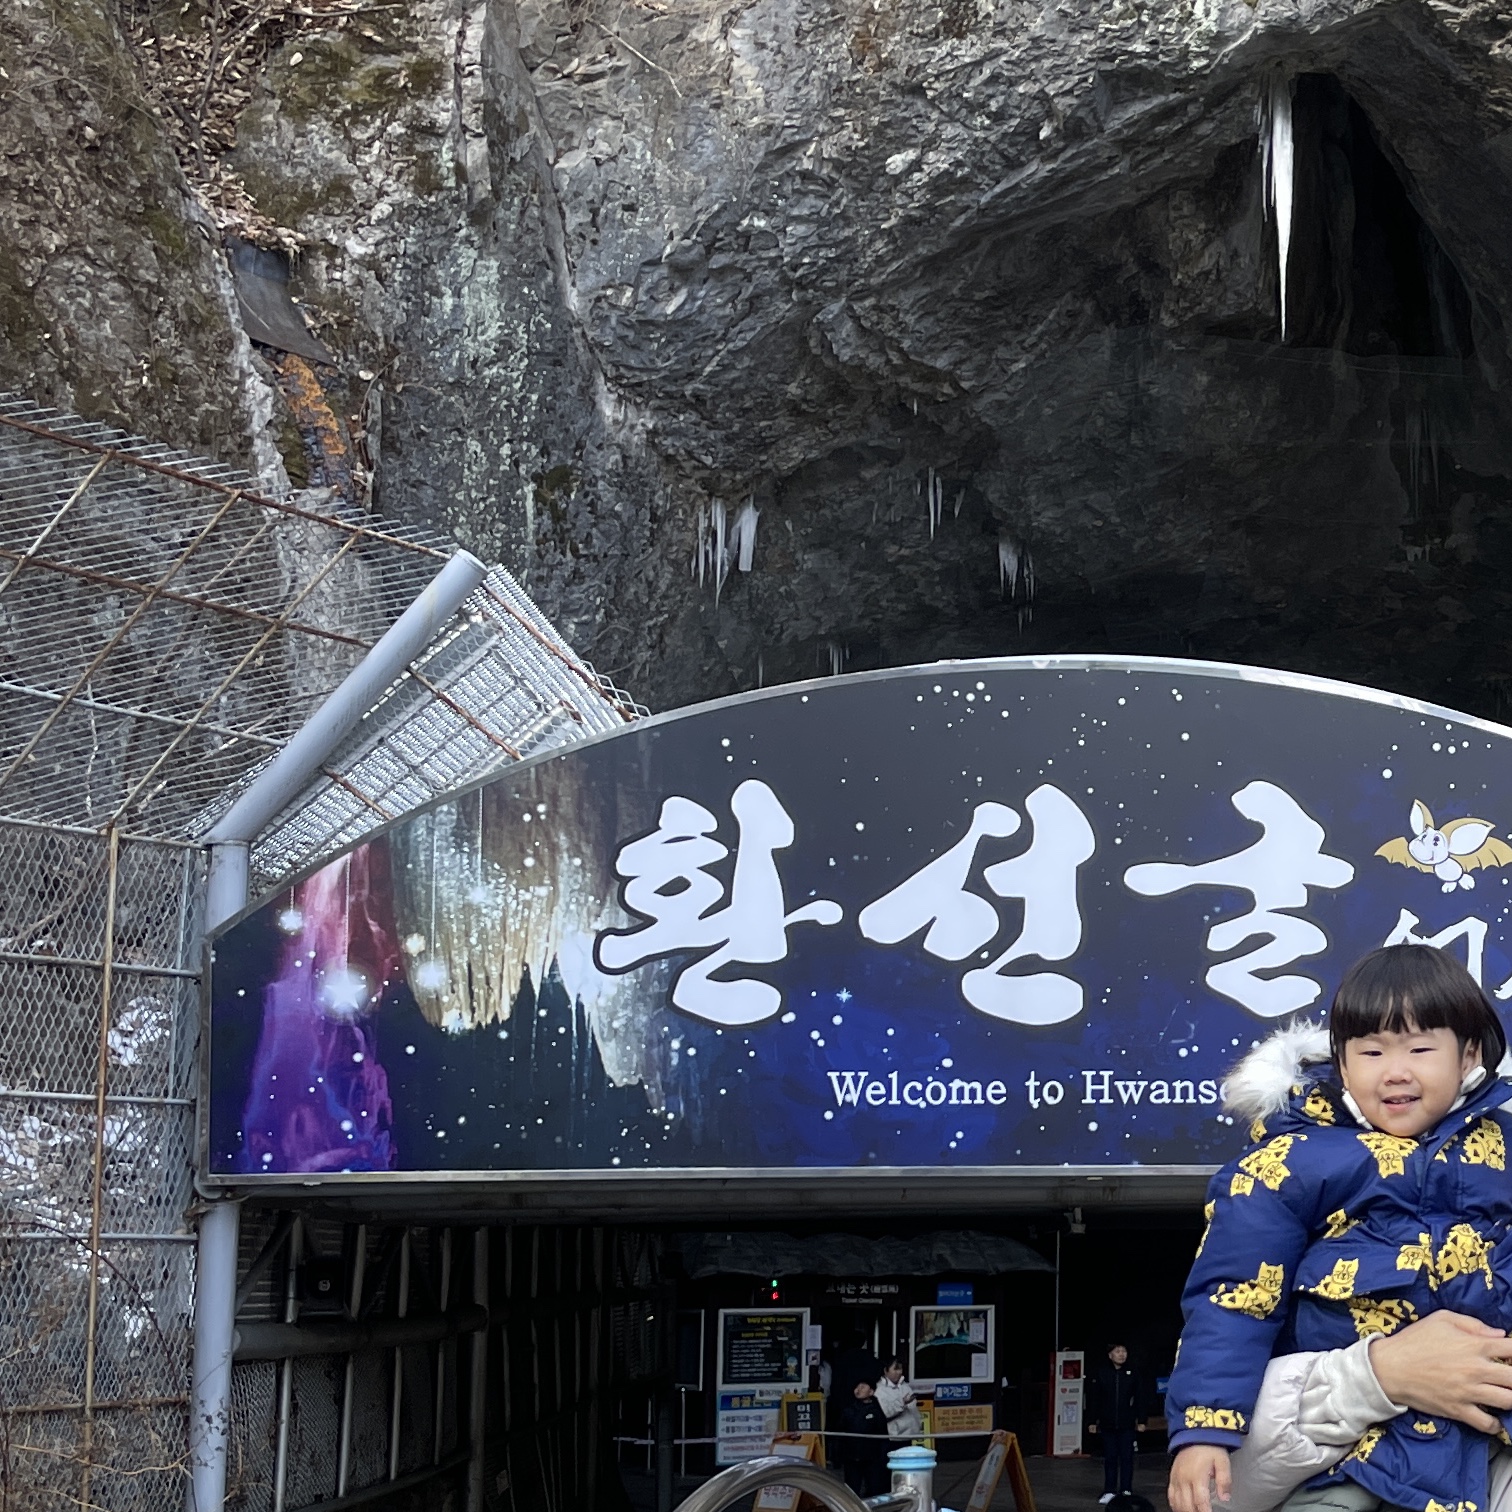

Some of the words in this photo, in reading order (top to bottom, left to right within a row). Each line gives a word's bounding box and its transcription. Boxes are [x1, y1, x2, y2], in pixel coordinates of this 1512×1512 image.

[595, 778, 1355, 1026] 환선굴
[827, 1070, 1008, 1107] Welcome
[1025, 1070, 1065, 1107] to
